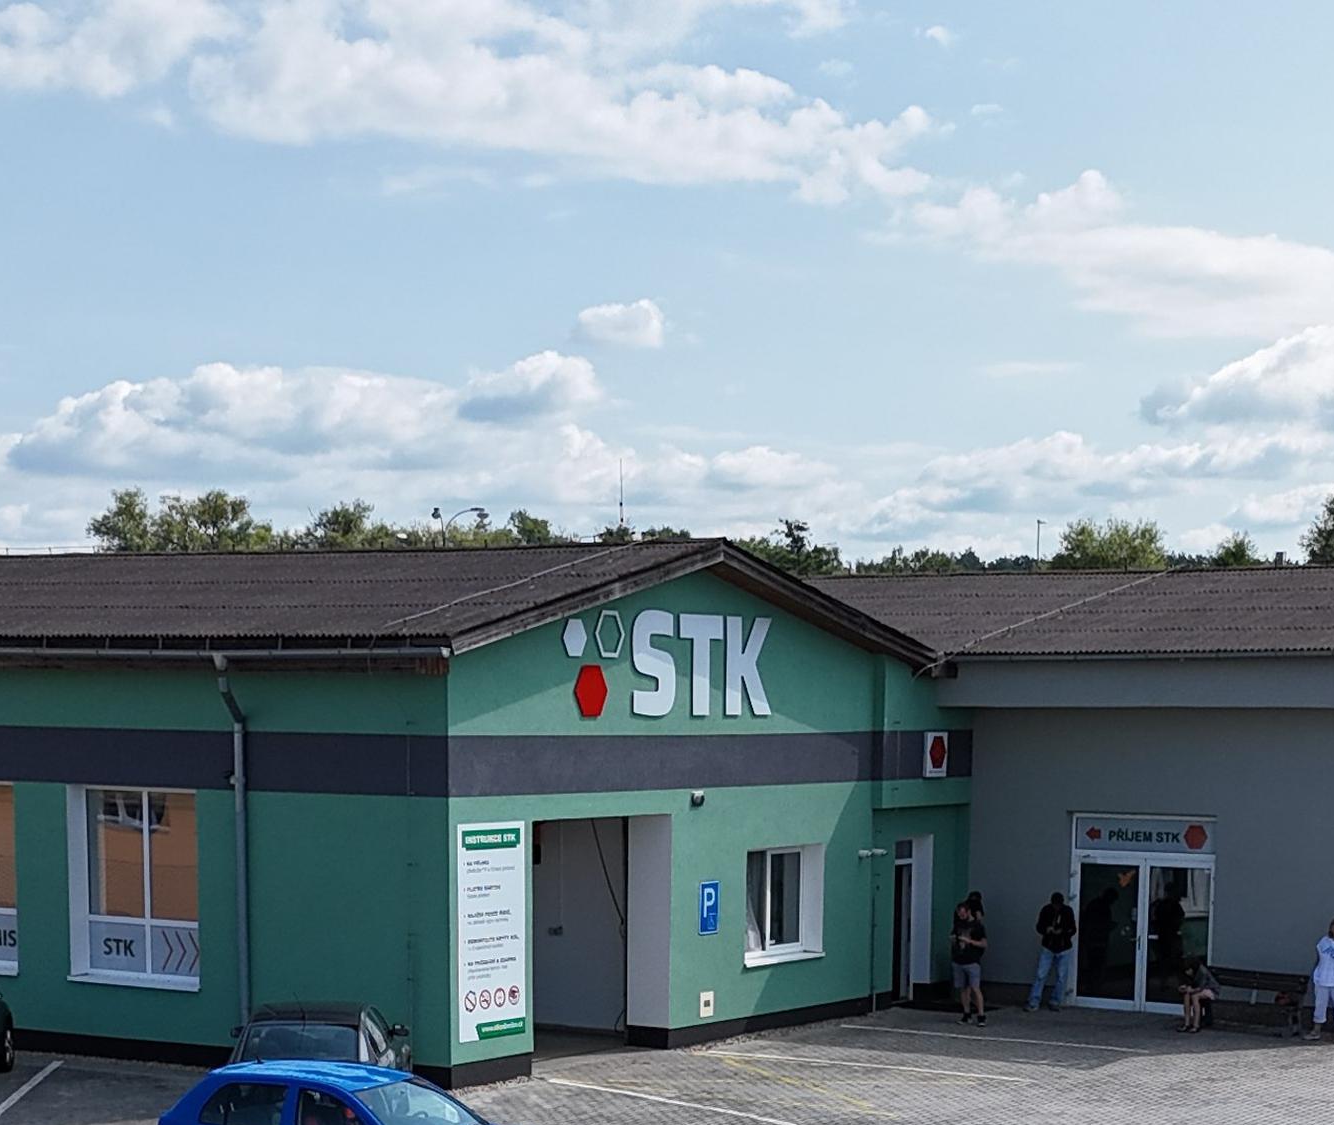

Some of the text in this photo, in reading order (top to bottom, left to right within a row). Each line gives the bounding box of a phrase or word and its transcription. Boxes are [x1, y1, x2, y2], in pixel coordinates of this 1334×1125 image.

[632, 609, 772, 717] STK
[1108, 828, 1181, 843] PŘÍJEM STK
[703, 888, 716, 918] P
[103, 937, 135, 958] STK
